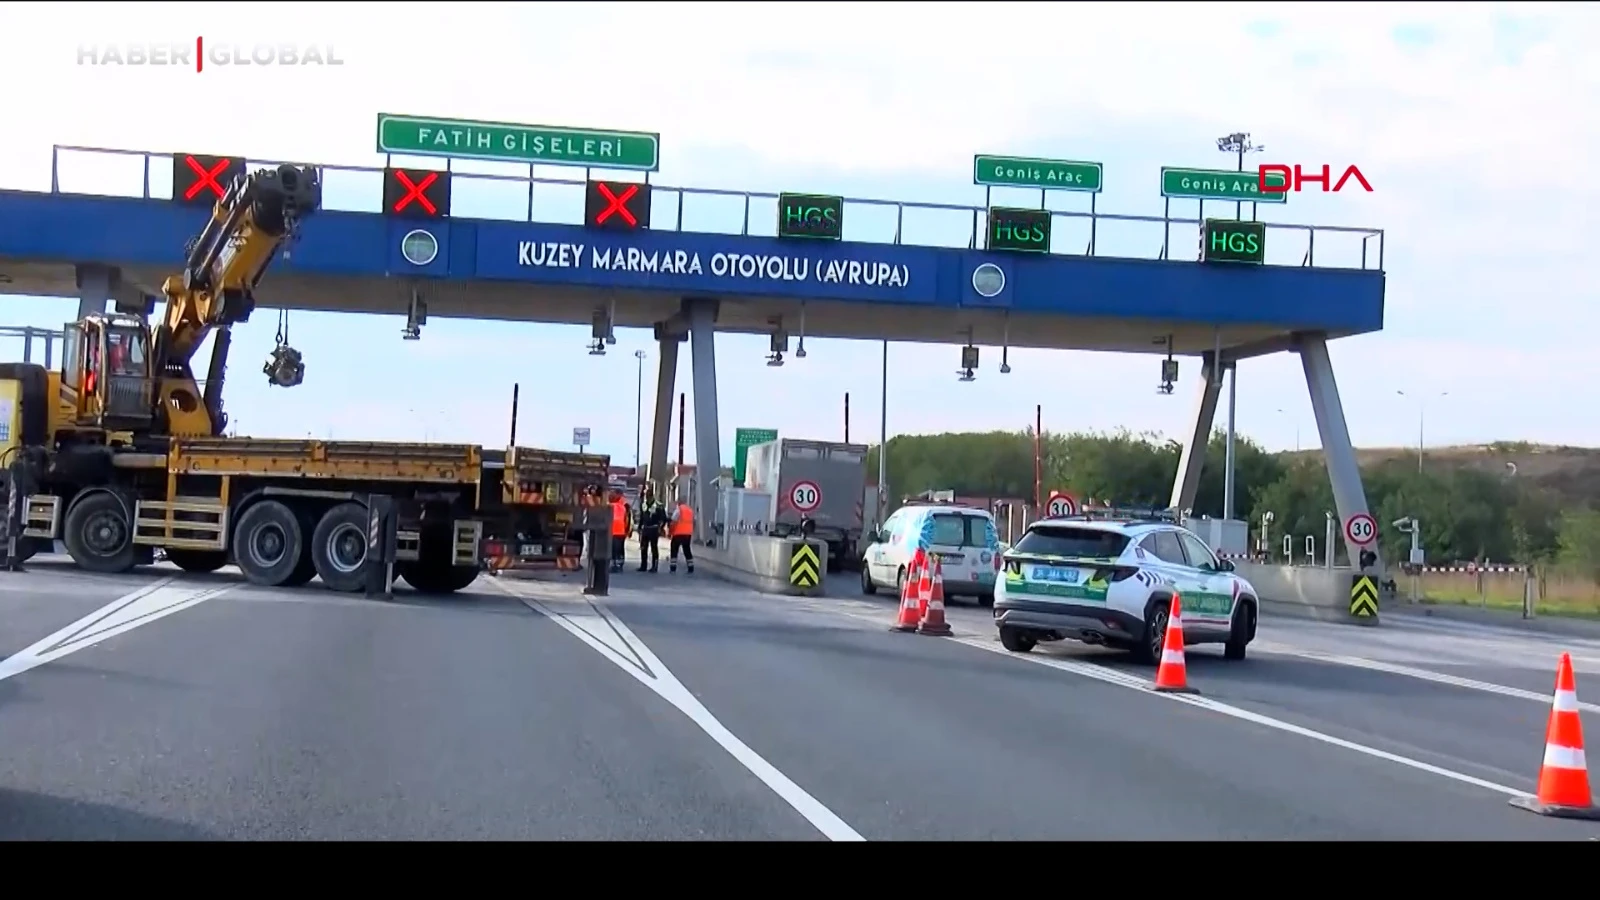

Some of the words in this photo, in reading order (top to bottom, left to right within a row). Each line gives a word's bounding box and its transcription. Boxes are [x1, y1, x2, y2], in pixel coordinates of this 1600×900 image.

[418, 128, 491, 148] FATİH
[503, 132, 622, 157] GİŞELERİ
[995, 165, 1041, 181] Geniş
[1047, 169, 1083, 184] Araç
[1181, 177, 1227, 193] Geniş
[1232, 179, 1266, 195] Ara
[786, 205, 836, 229] HGS
[996, 219, 1045, 243] HGS
[1211, 231, 1259, 254] HGS
[518, 241, 585, 268] KUZEY
[592, 246, 703, 275] MARMARA
[710, 252, 809, 281] OTOYOLU
[815, 258, 910, 287] (AVRUPA)
[796, 489, 816, 504] 30
[1052, 502, 1070, 516] 30
[1353, 522, 1372, 537] 30
